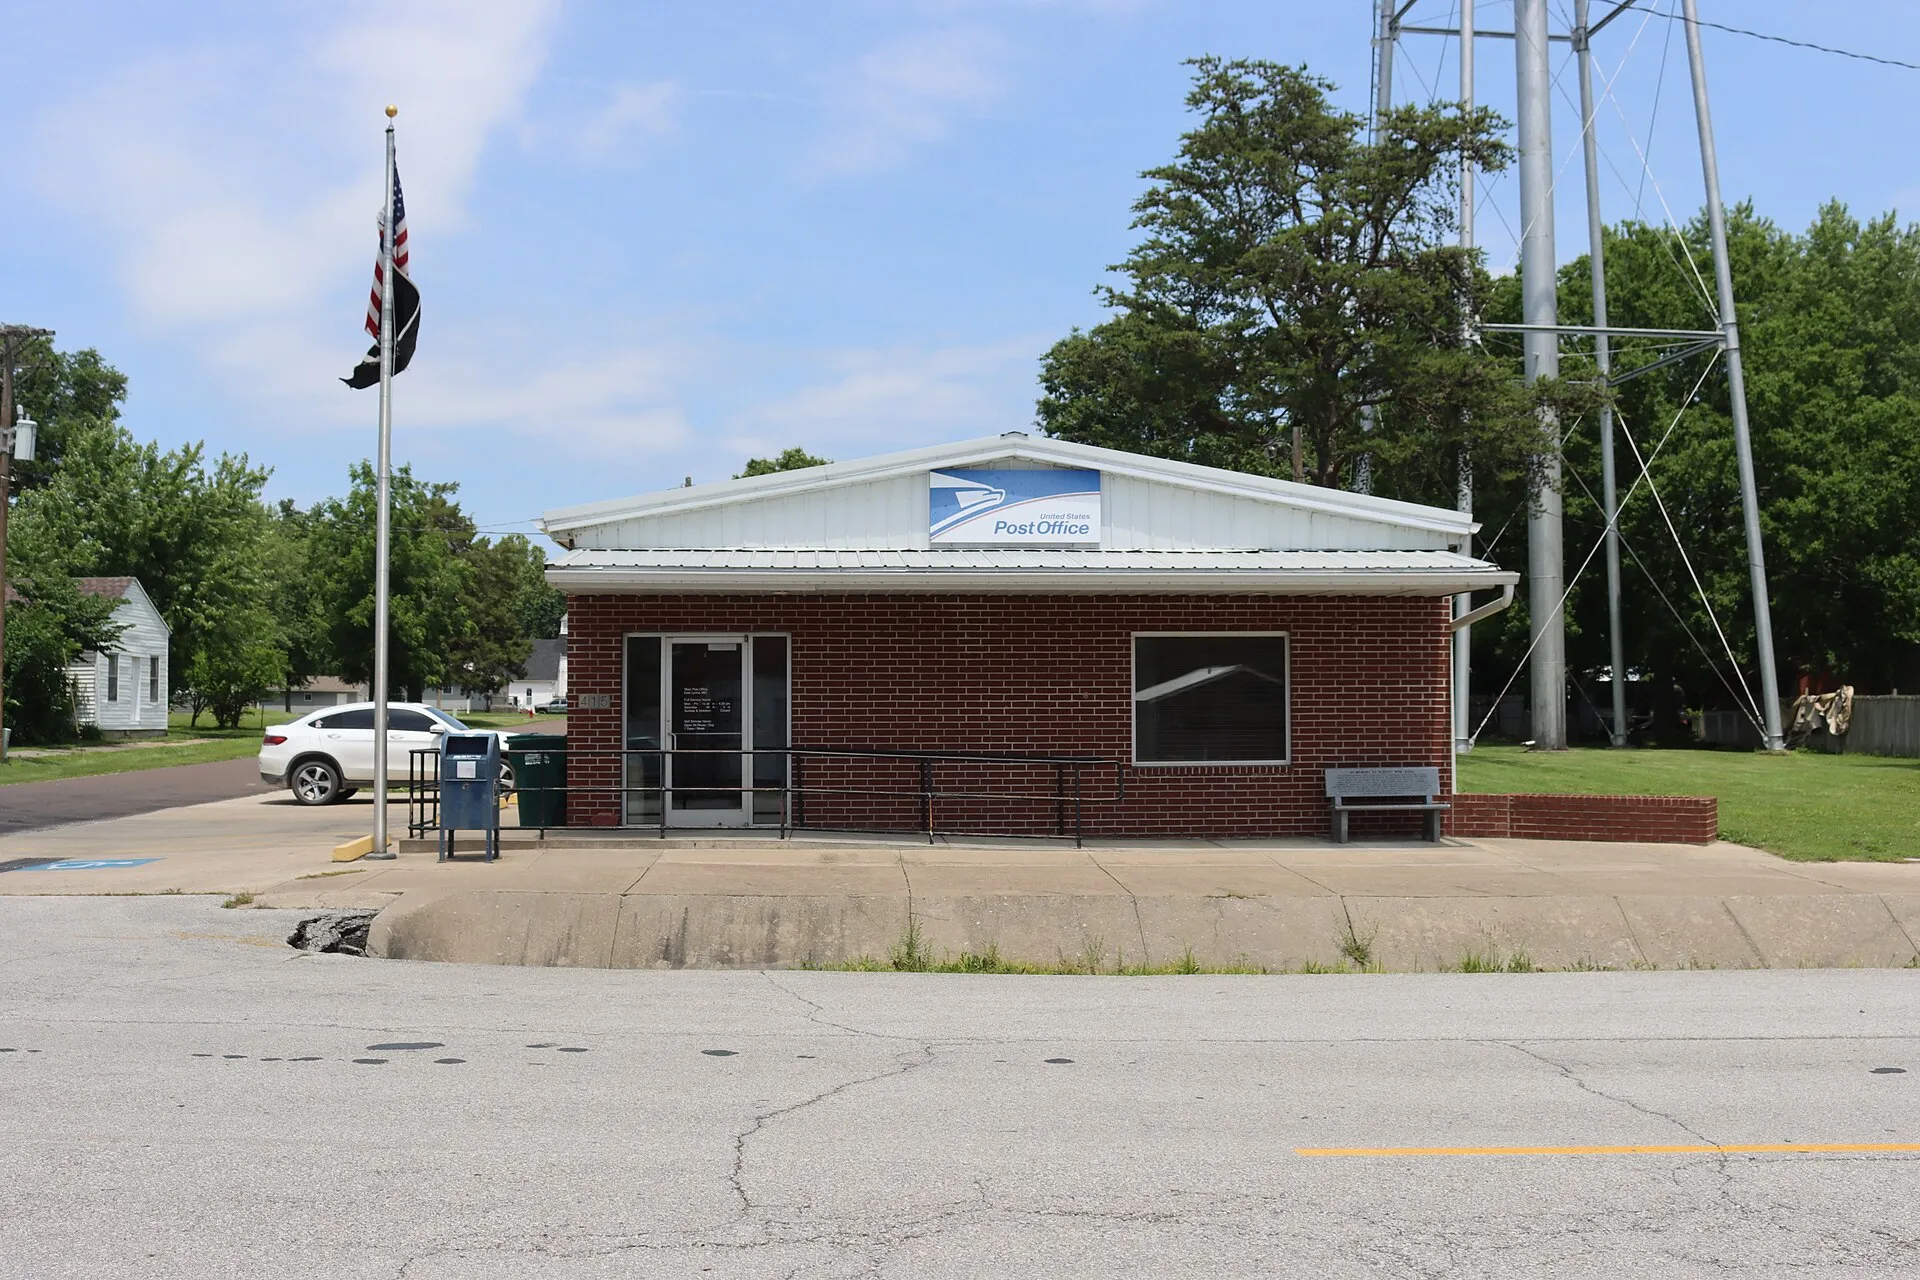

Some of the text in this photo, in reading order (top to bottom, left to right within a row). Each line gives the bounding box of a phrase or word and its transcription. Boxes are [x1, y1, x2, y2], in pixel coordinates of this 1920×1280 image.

[994, 520, 1089, 535] Post Office
[580, 695, 609, 707] 415
